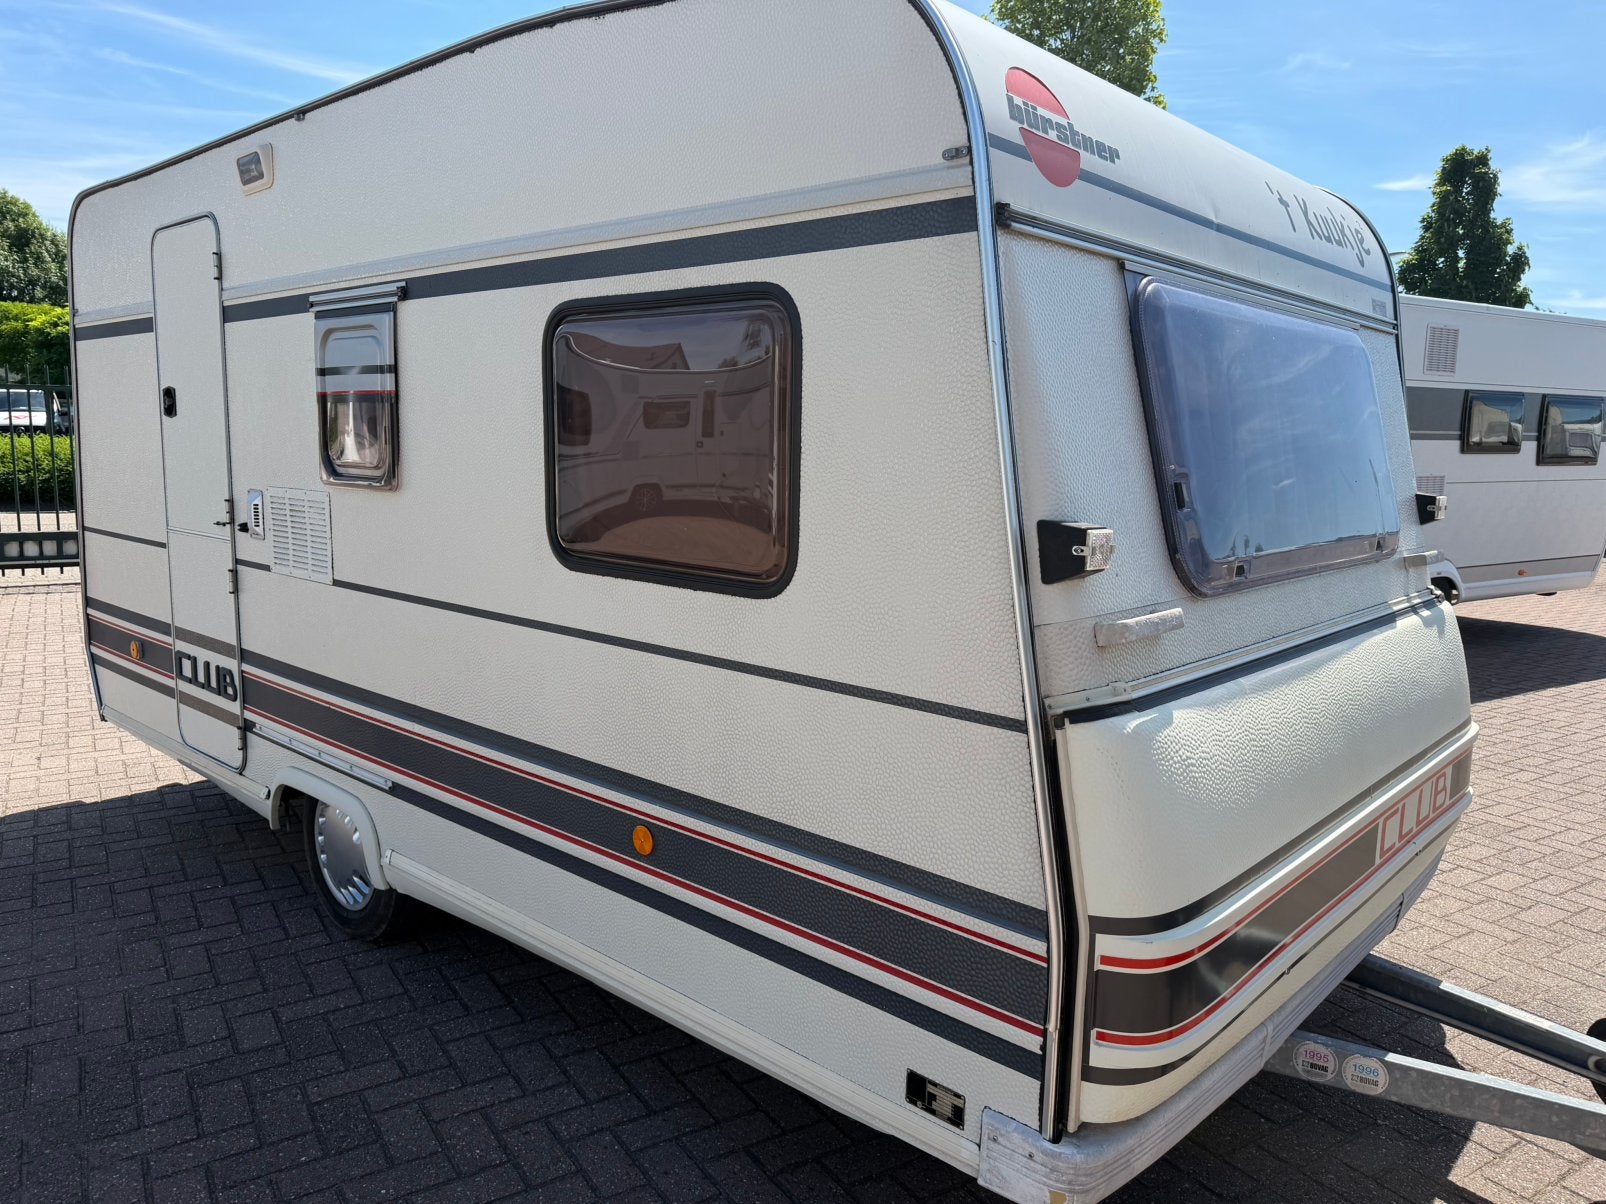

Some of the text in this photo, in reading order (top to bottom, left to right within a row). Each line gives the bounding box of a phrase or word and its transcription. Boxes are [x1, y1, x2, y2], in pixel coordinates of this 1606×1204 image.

[1006, 94, 1120, 164] bürstner
[1293, 193, 1371, 268] Kuukje
[175, 650, 238, 702] CLUB
[1379, 771, 1447, 860] CLUB
[1303, 1050, 1330, 1063] 1995
[1353, 1064, 1380, 1077] 1996
